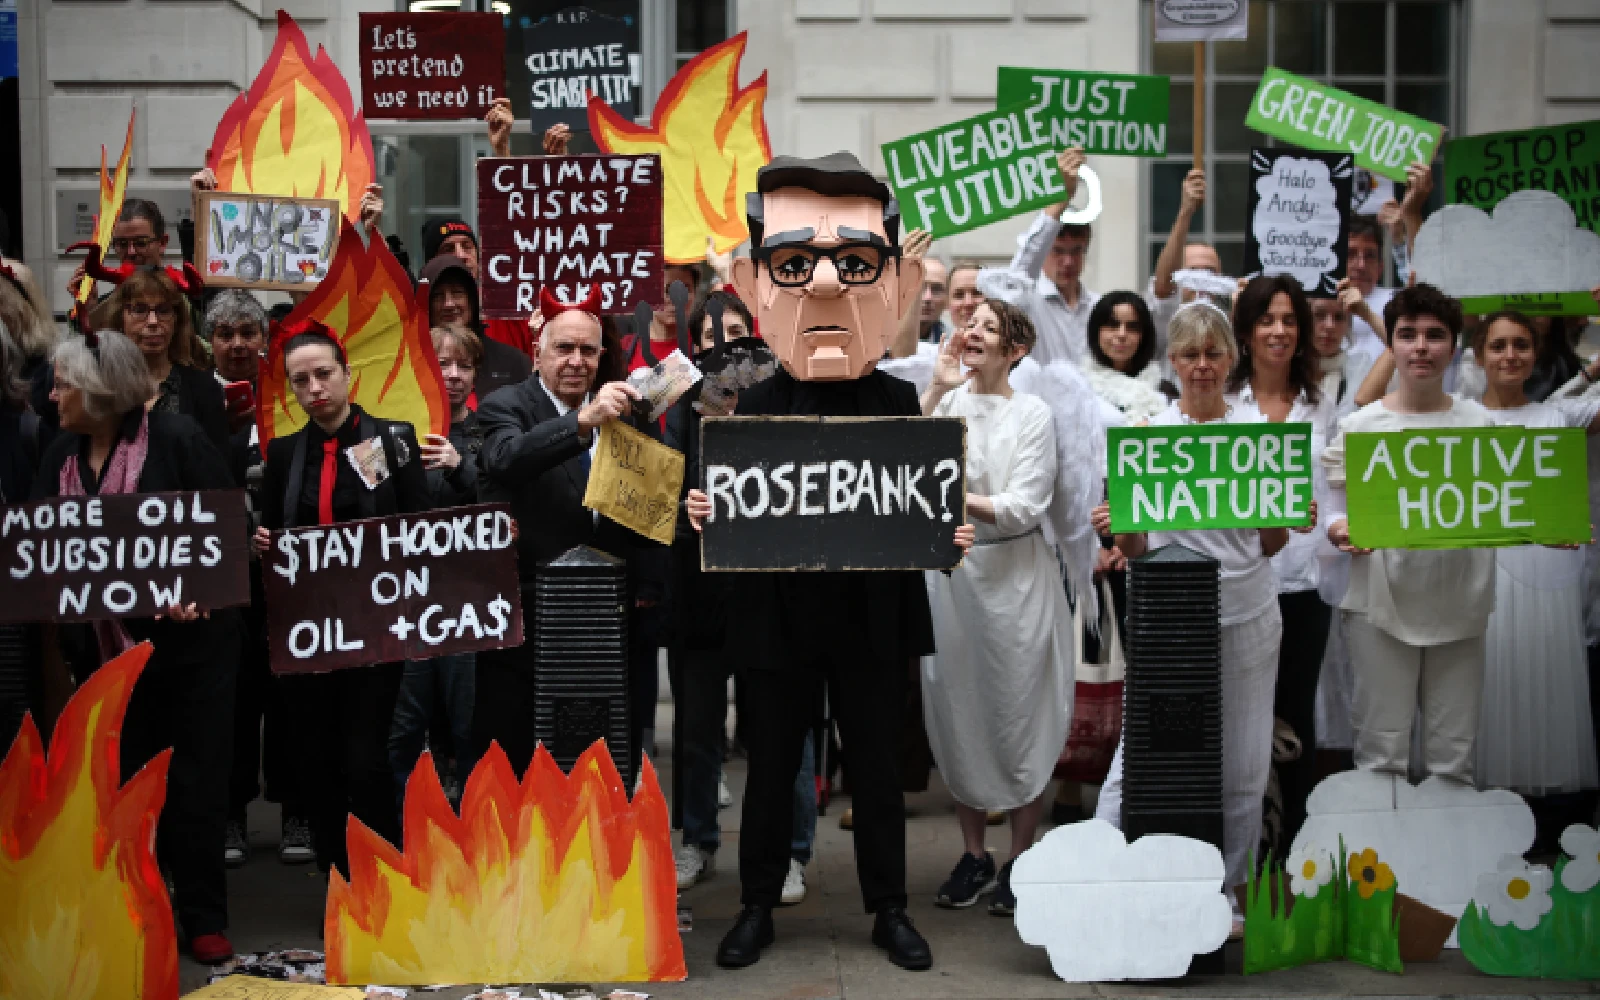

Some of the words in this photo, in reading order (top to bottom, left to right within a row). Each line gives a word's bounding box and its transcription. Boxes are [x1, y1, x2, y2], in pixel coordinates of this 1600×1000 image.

[372, 25, 417, 51] Let's
[372, 54, 464, 80] pretend
[525, 43, 624, 74] CLIMATE
[373, 90, 408, 108] we
[417, 85, 469, 109] need
[477, 84, 495, 107] it
[1031, 75, 1136, 114] JUST
[1051, 117, 1167, 154] NSITION
[1257, 78, 1354, 144] GREEN
[1349, 112, 1433, 171] JOBS
[890, 106, 1051, 189] LIVEABLE
[1484, 129, 1586, 171] STOP
[492, 159, 654, 192] CLIMATE
[914, 149, 1065, 233] FUTURE
[1278, 169, 1316, 189] Halo
[245, 200, 304, 235] NO
[507, 186, 629, 221] RISKS?
[1267, 193, 1320, 223] Andy:
[226, 224, 320, 255] MORE
[513, 222, 613, 253] WHAT
[1266, 227, 1328, 254] Goodbye
[236, 251, 305, 284] OIL
[488, 249, 655, 283] CLIMATE
[1263, 249, 1331, 268] Jackdaw
[516, 279, 634, 312] RSKS?
[1117, 433, 1306, 477] RESTORE
[1361, 435, 1562, 482] ACTIVE
[705, 459, 960, 524] ROSEBANK?
[1131, 477, 1309, 524] NATURE
[1397, 480, 1536, 529] HOPE
[2, 499, 103, 538] MORE
[137, 491, 217, 527] OIL
[9, 534, 222, 579] SUBSIDIES
[272, 524, 364, 586] $TAY
[380, 511, 512, 561] HOOKED
[58, 573, 183, 615] NOW
[370, 565, 430, 605] ON
[287, 616, 365, 658] OIL
